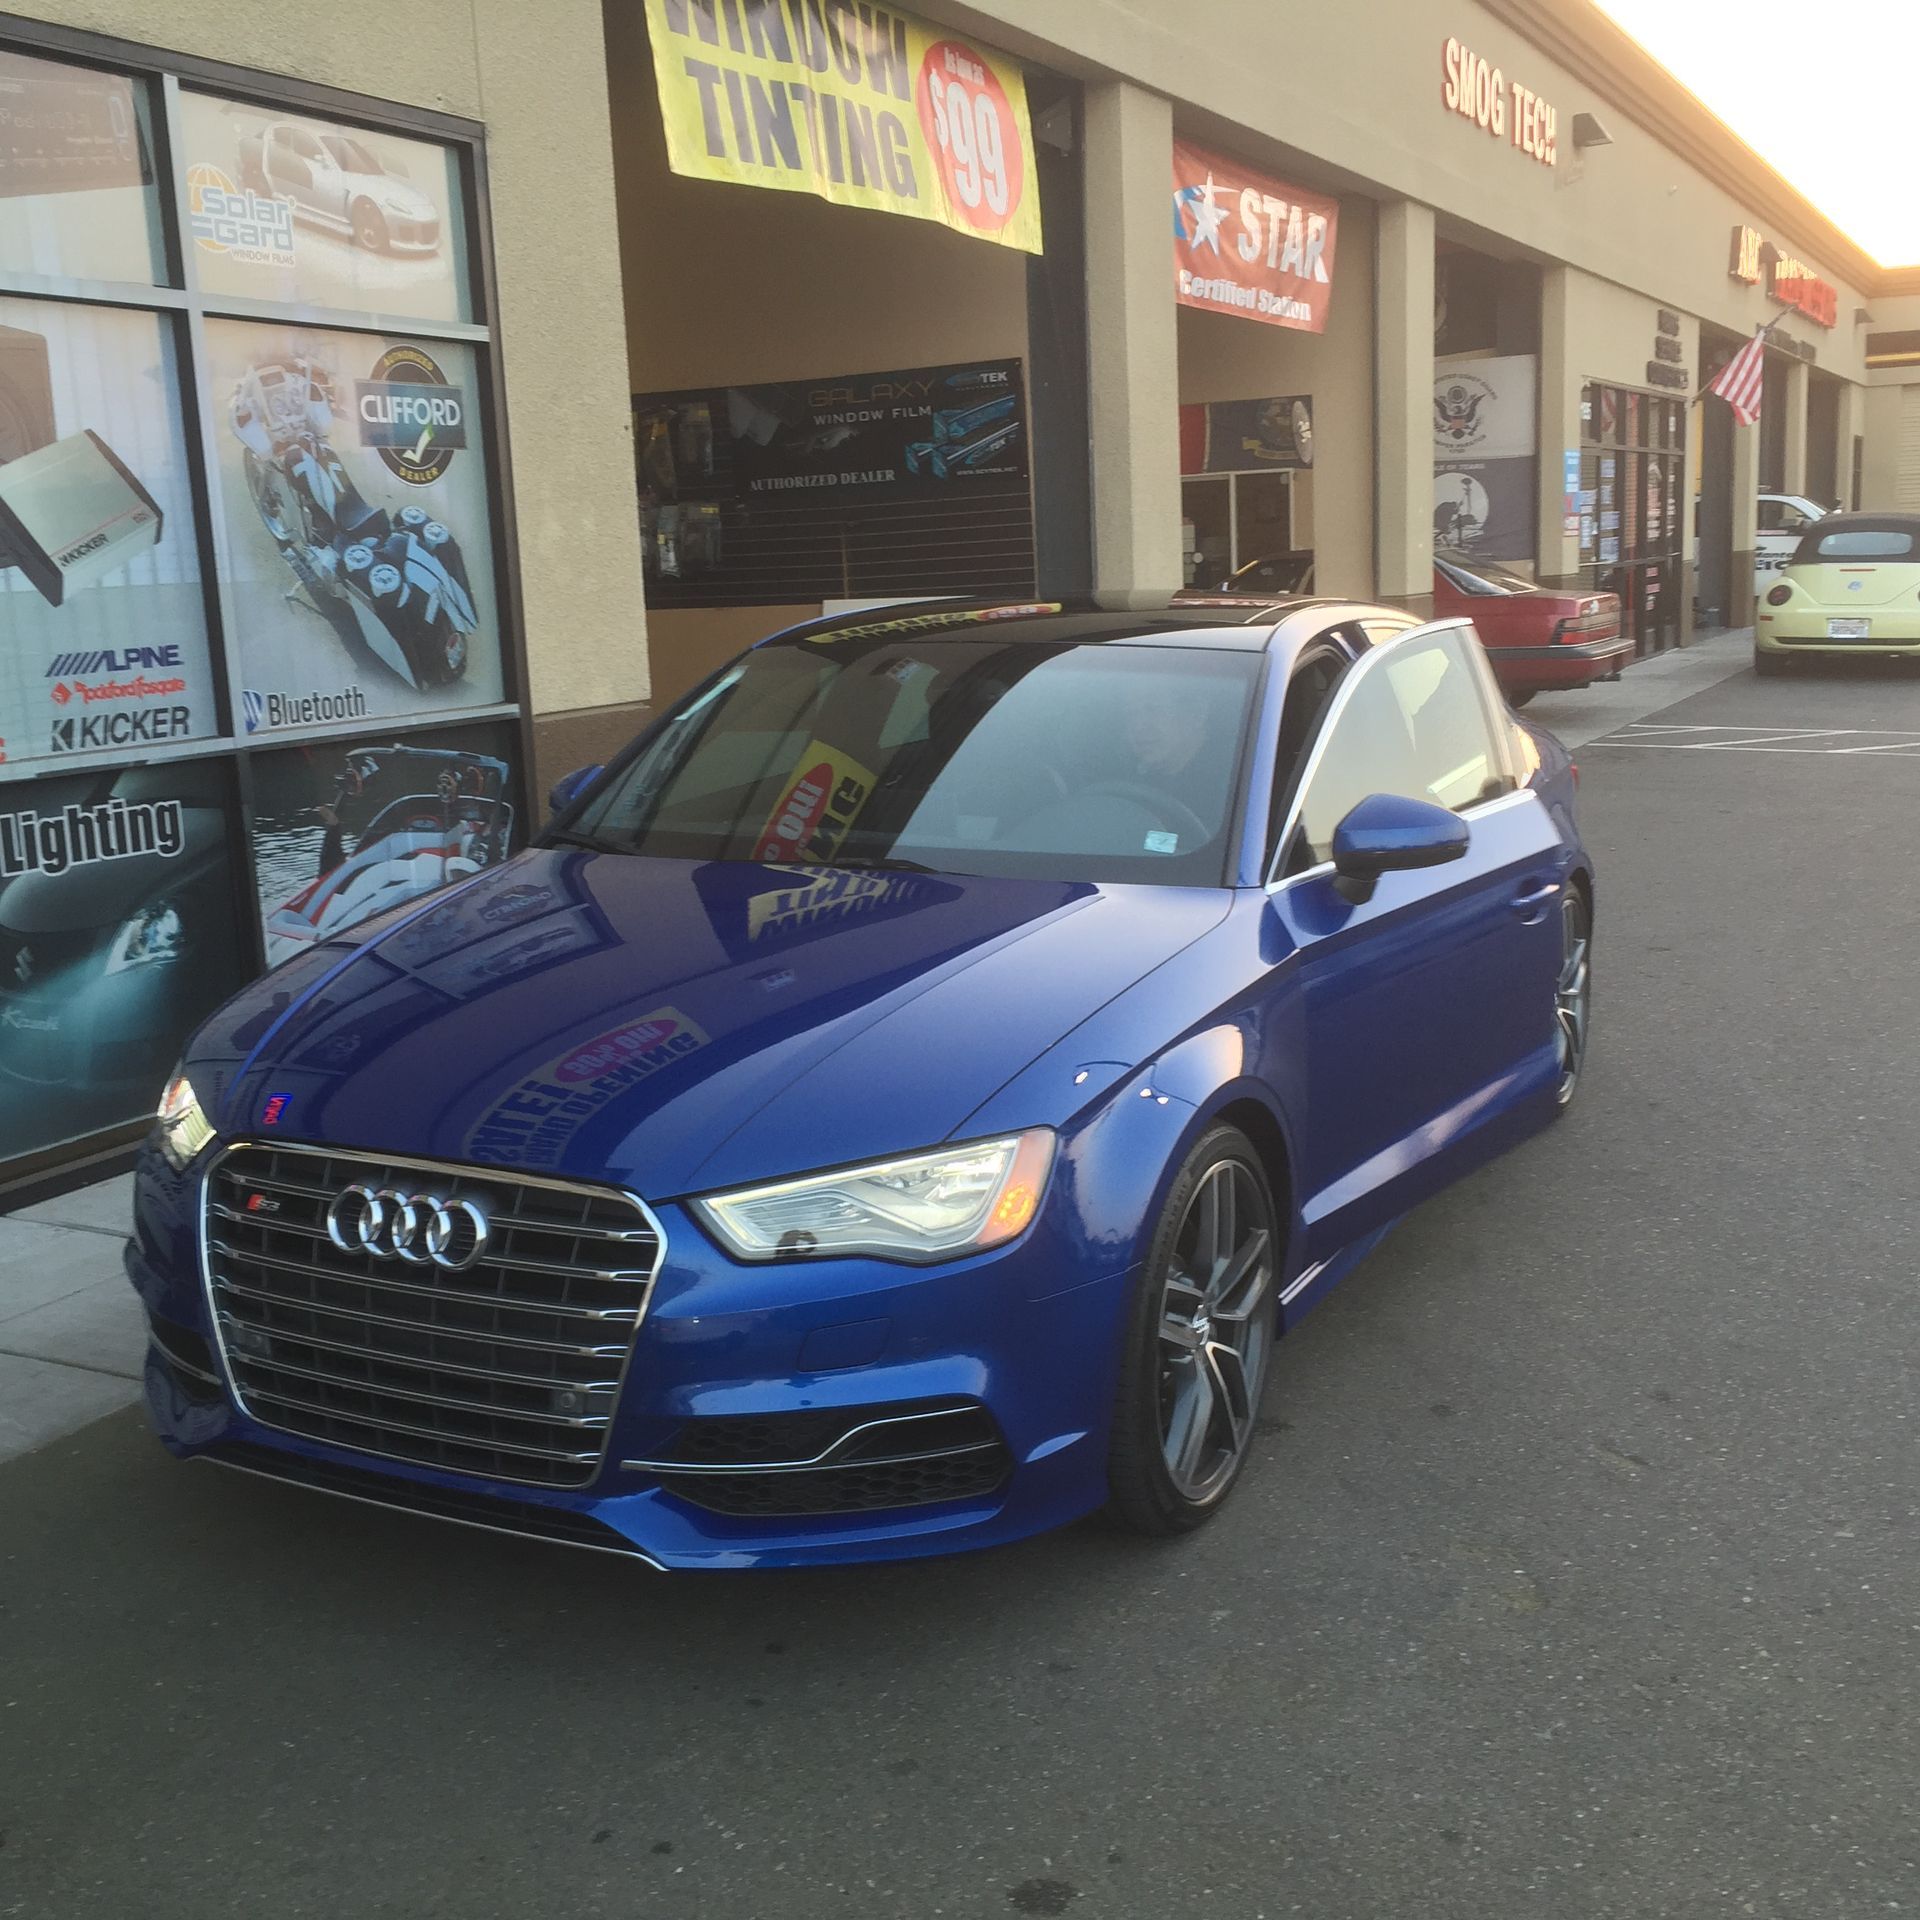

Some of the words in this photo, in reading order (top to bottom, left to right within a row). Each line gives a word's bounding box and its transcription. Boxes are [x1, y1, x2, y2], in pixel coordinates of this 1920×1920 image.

[1442, 36, 1505, 137] SMOG
[1511, 81, 1557, 166] TECH
[684, 56, 919, 200] TINTING
[929, 67, 1009, 216] $99
[201, 186, 291, 227] Solar
[213, 218, 294, 252] Gard
[231, 247, 270, 262] WINDOW
[1237, 187, 1330, 284] STAR
[1179, 269, 1257, 310] Certified
[1257, 288, 1312, 322] Station
[360, 394, 462, 427] CLIFFORD
[808, 378, 937, 408] GALAXY
[812, 409, 885, 426] WINDOW
[892, 405, 932, 419] FILM
[399, 465, 440, 482] DEALER
[750, 474, 838, 492] AUTHORIZED
[840, 469, 897, 485] DEALER
[60, 644, 185, 677] ALPINE
[266, 685, 366, 727] Bluetooth
[80, 705, 191, 750] KICKER
[0, 799, 186, 877] Lighting
